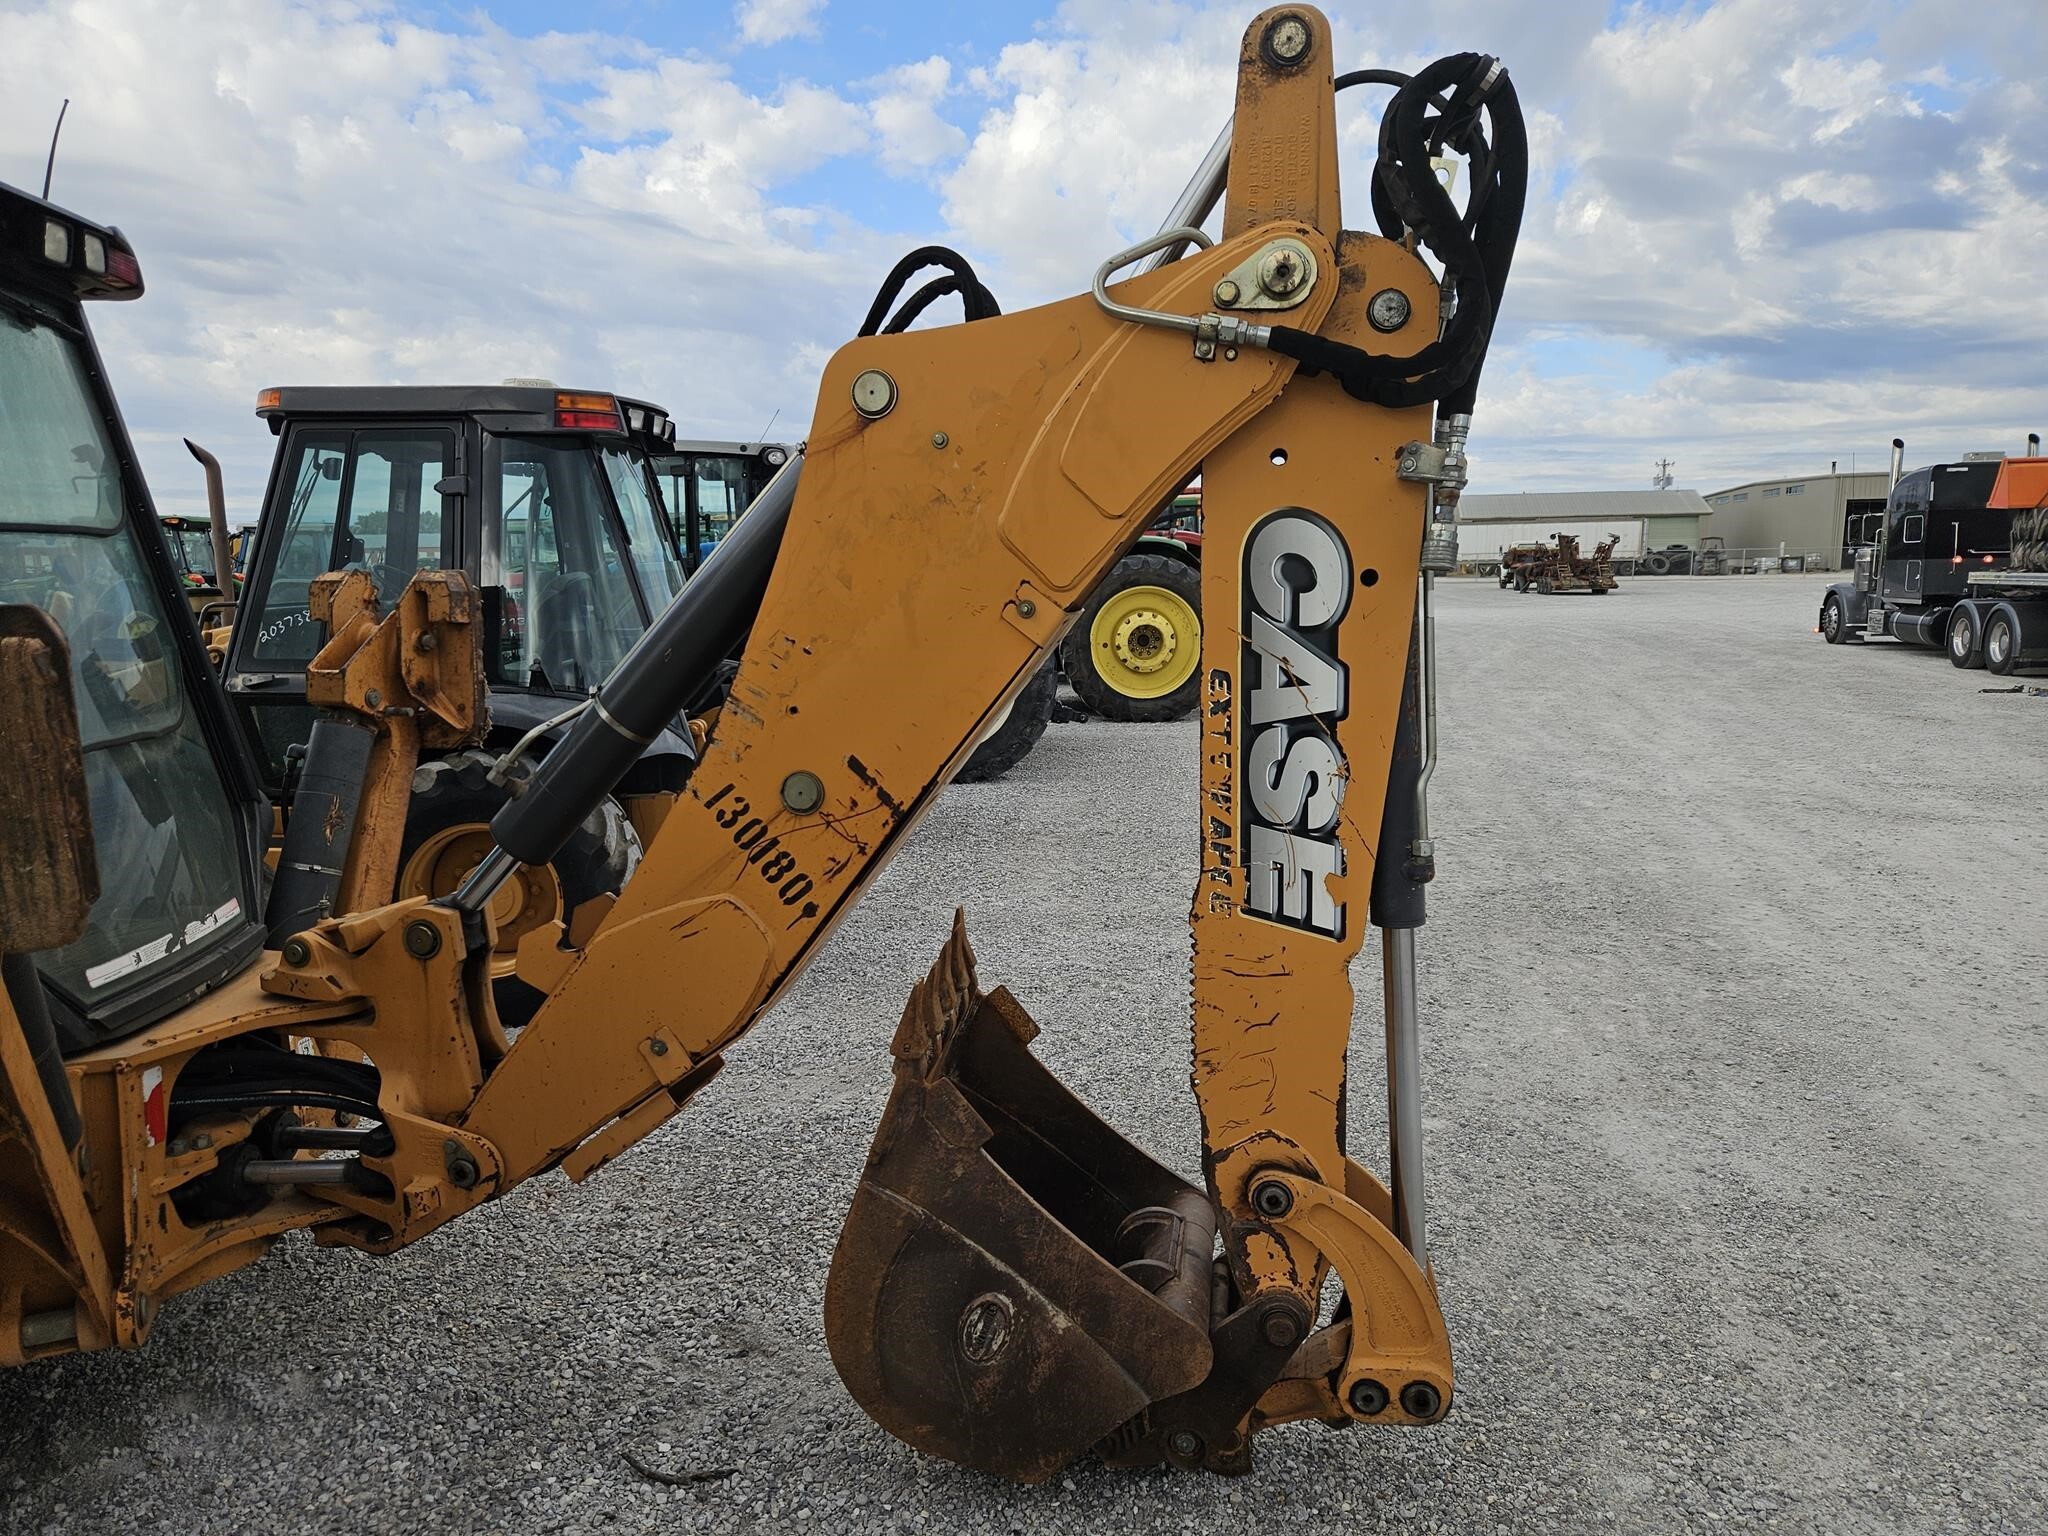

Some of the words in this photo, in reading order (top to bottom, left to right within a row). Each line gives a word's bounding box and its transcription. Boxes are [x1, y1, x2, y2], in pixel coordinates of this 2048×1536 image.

[1273, 159, 1284, 182] NOT
[1300, 113, 1311, 177] WARNING
[1287, 189, 1297, 221] IRON
[1249, 517, 1343, 931] CASE
[704, 783, 814, 906] 130180
